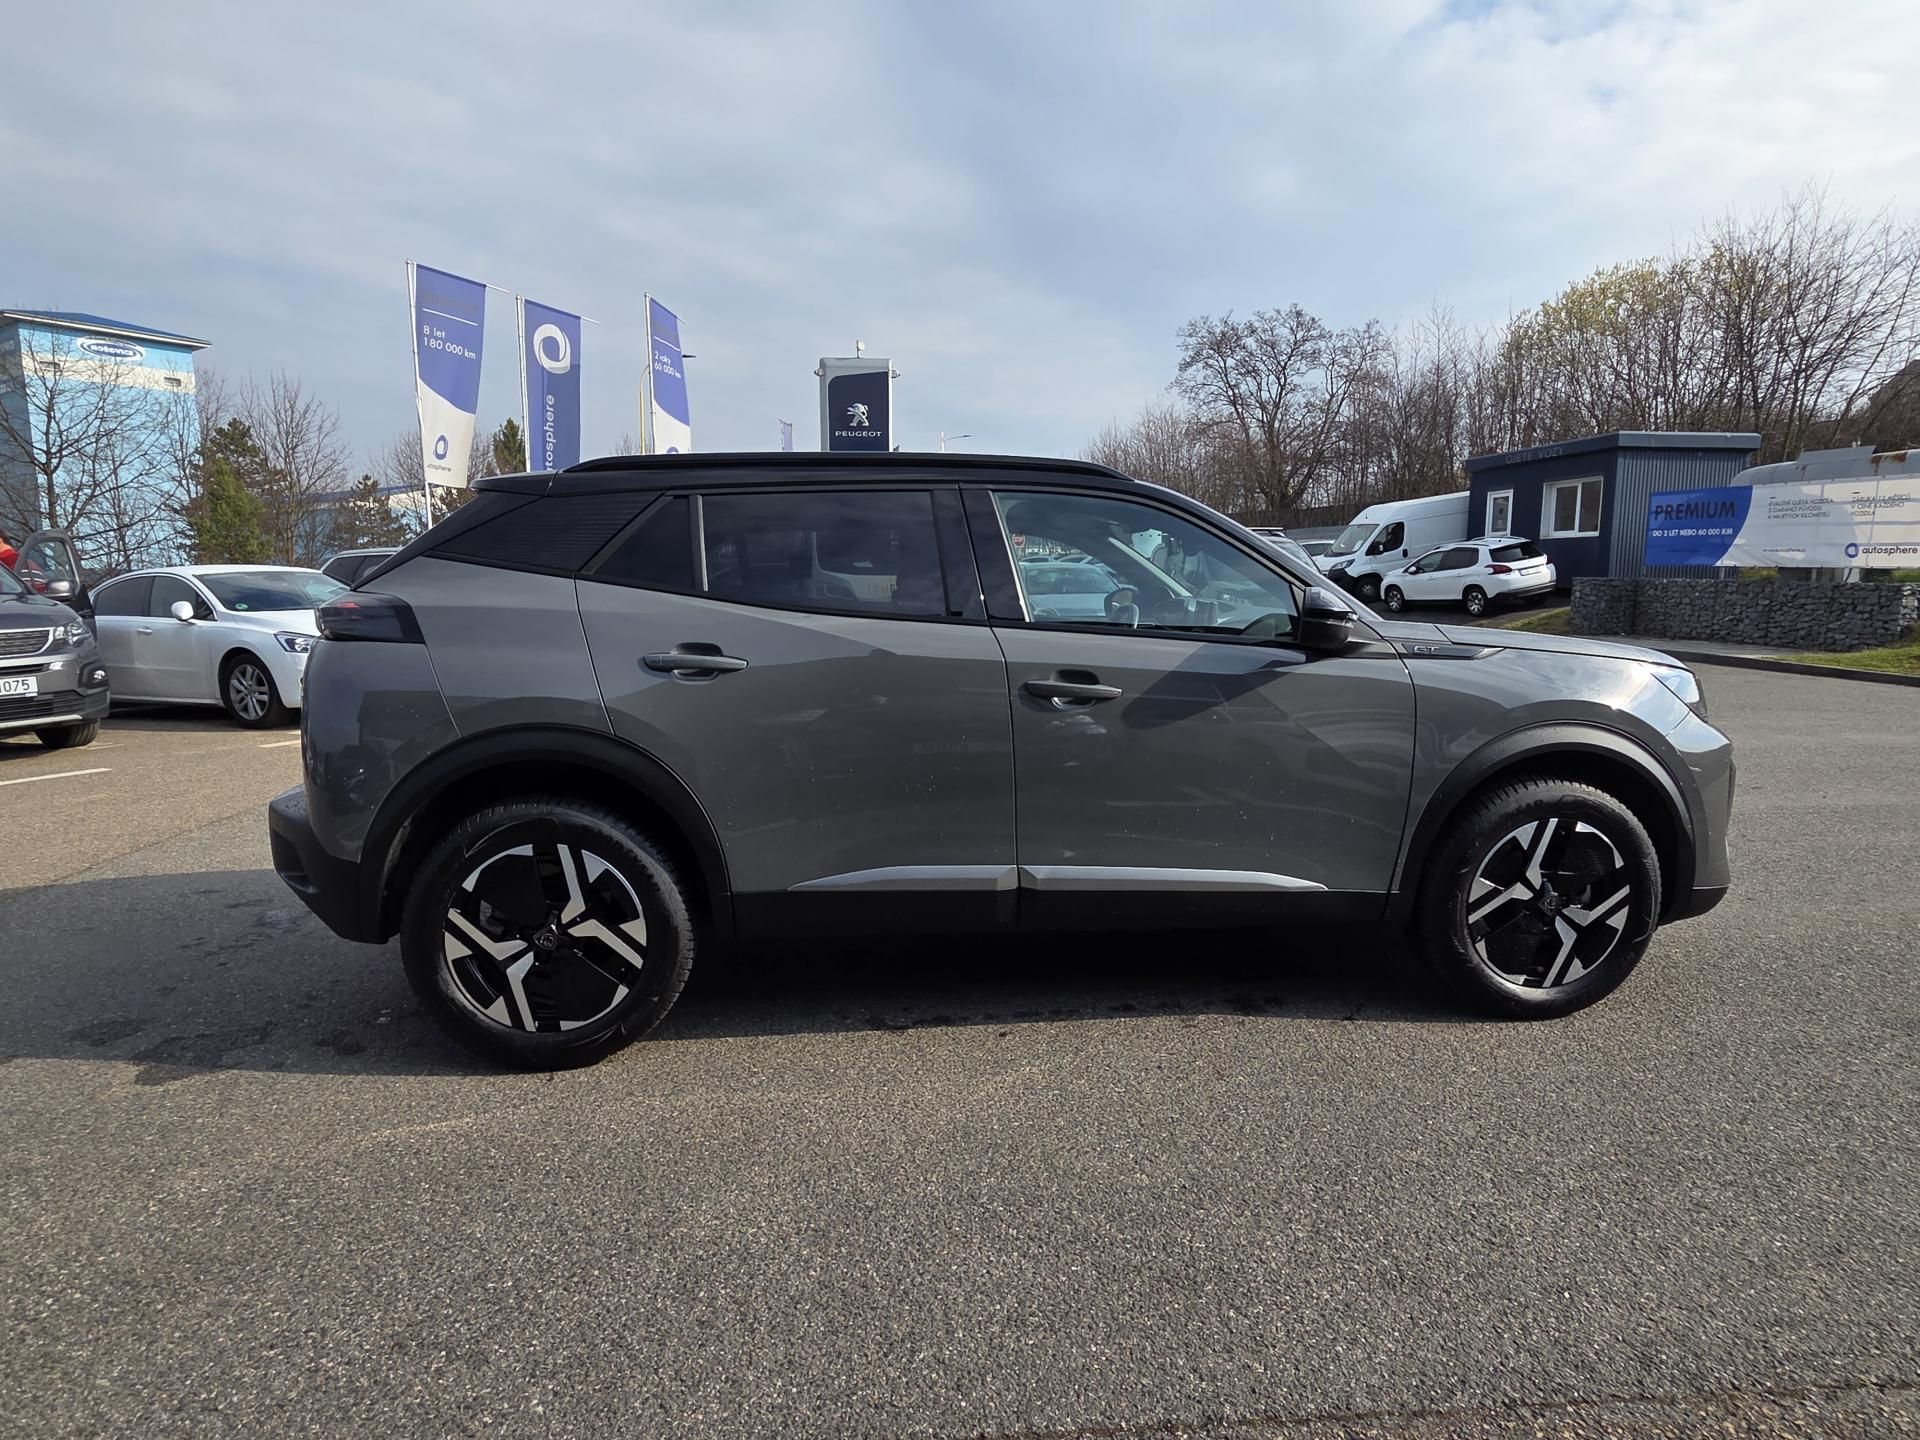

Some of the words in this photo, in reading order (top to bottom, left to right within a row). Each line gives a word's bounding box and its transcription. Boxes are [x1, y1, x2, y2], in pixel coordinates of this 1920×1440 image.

[423, 325, 430, 335] 8
[433, 327, 445, 338] let
[423, 337, 443, 350] 180
[445, 342, 463, 355] 000
[464, 348, 476, 359] km
[654, 350, 659, 360] 2
[663, 364, 675, 376] 000
[544, 394, 556, 471] tosphere
[1537, 445, 1566, 459] VOZY
[1654, 501, 1735, 520] PREMIUM
[1669, 529, 1679, 537] LET
[1698, 528, 1707, 536] 60
[1862, 545, 1918, 556] autosphere
[1414, 645, 1440, 655] GT
[0, 679, 30, 693] 075
